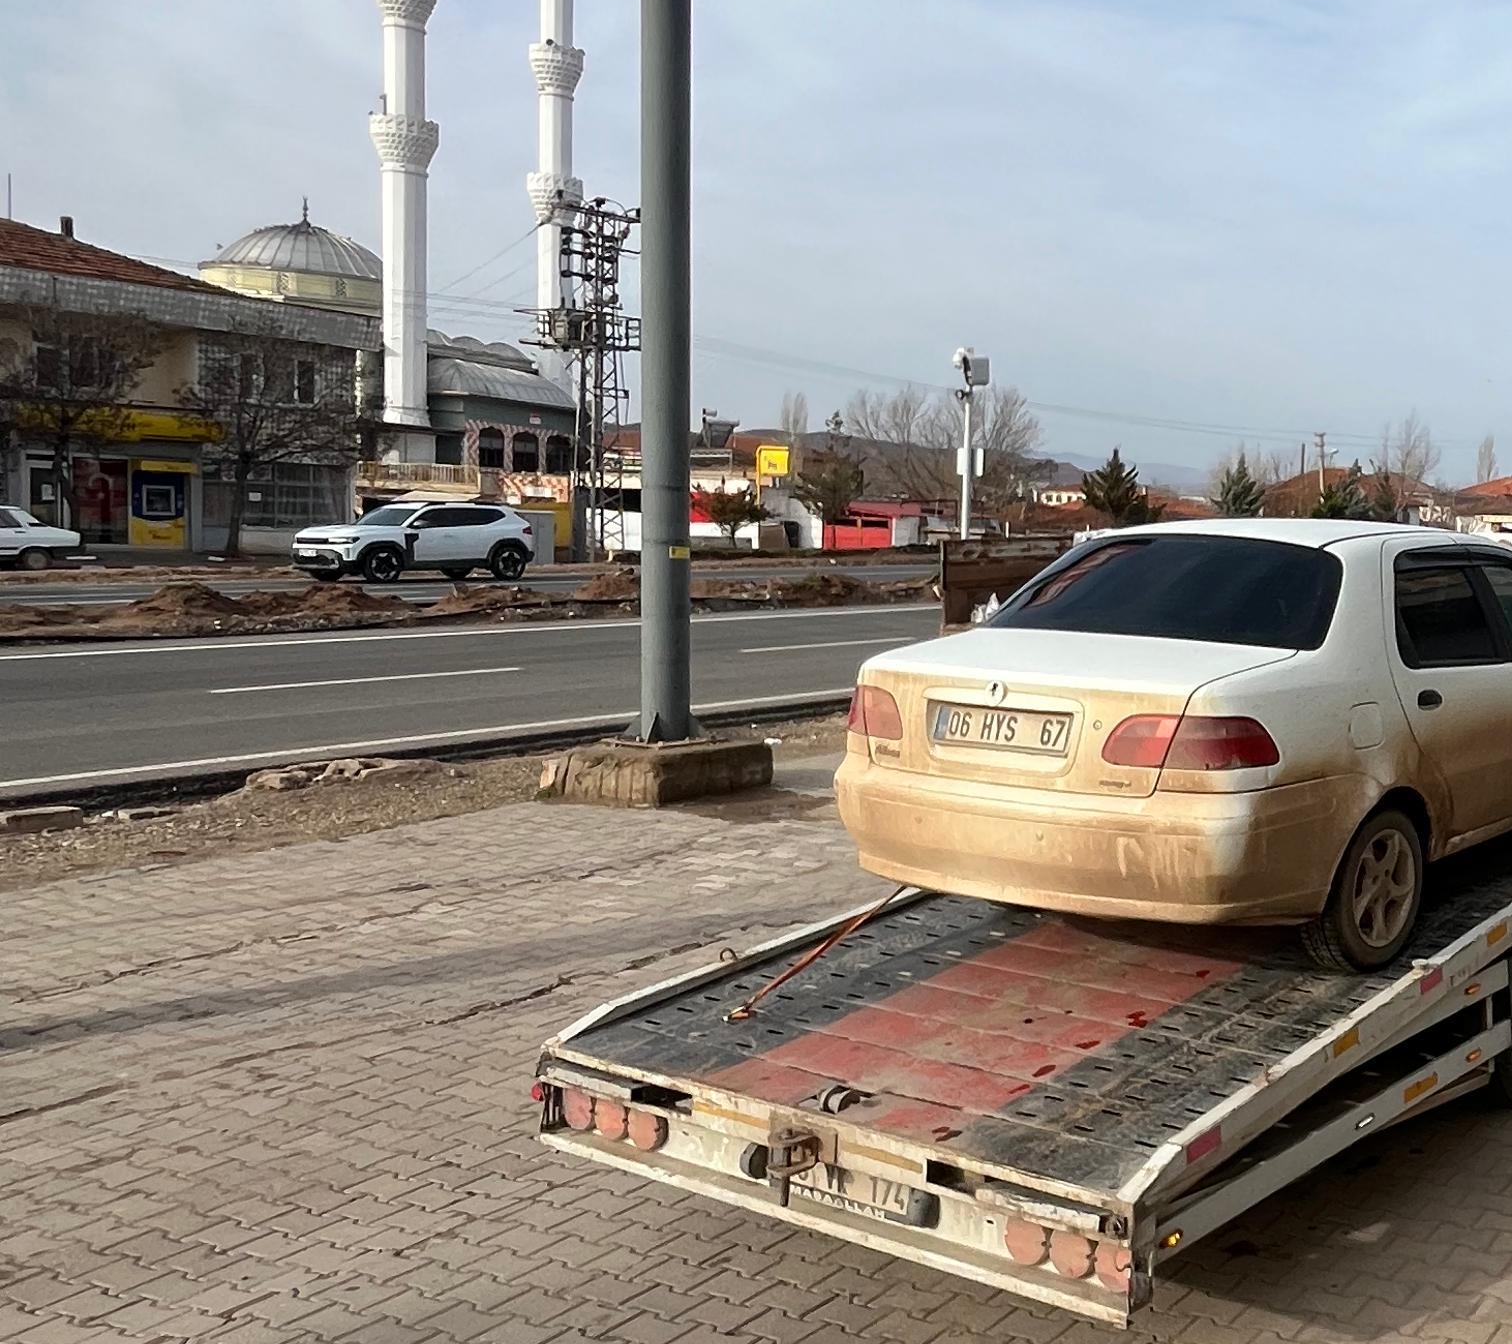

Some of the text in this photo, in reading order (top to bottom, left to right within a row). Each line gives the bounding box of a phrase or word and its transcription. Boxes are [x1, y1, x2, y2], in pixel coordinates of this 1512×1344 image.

[949, 711, 1067, 748] 06 HYS 67
